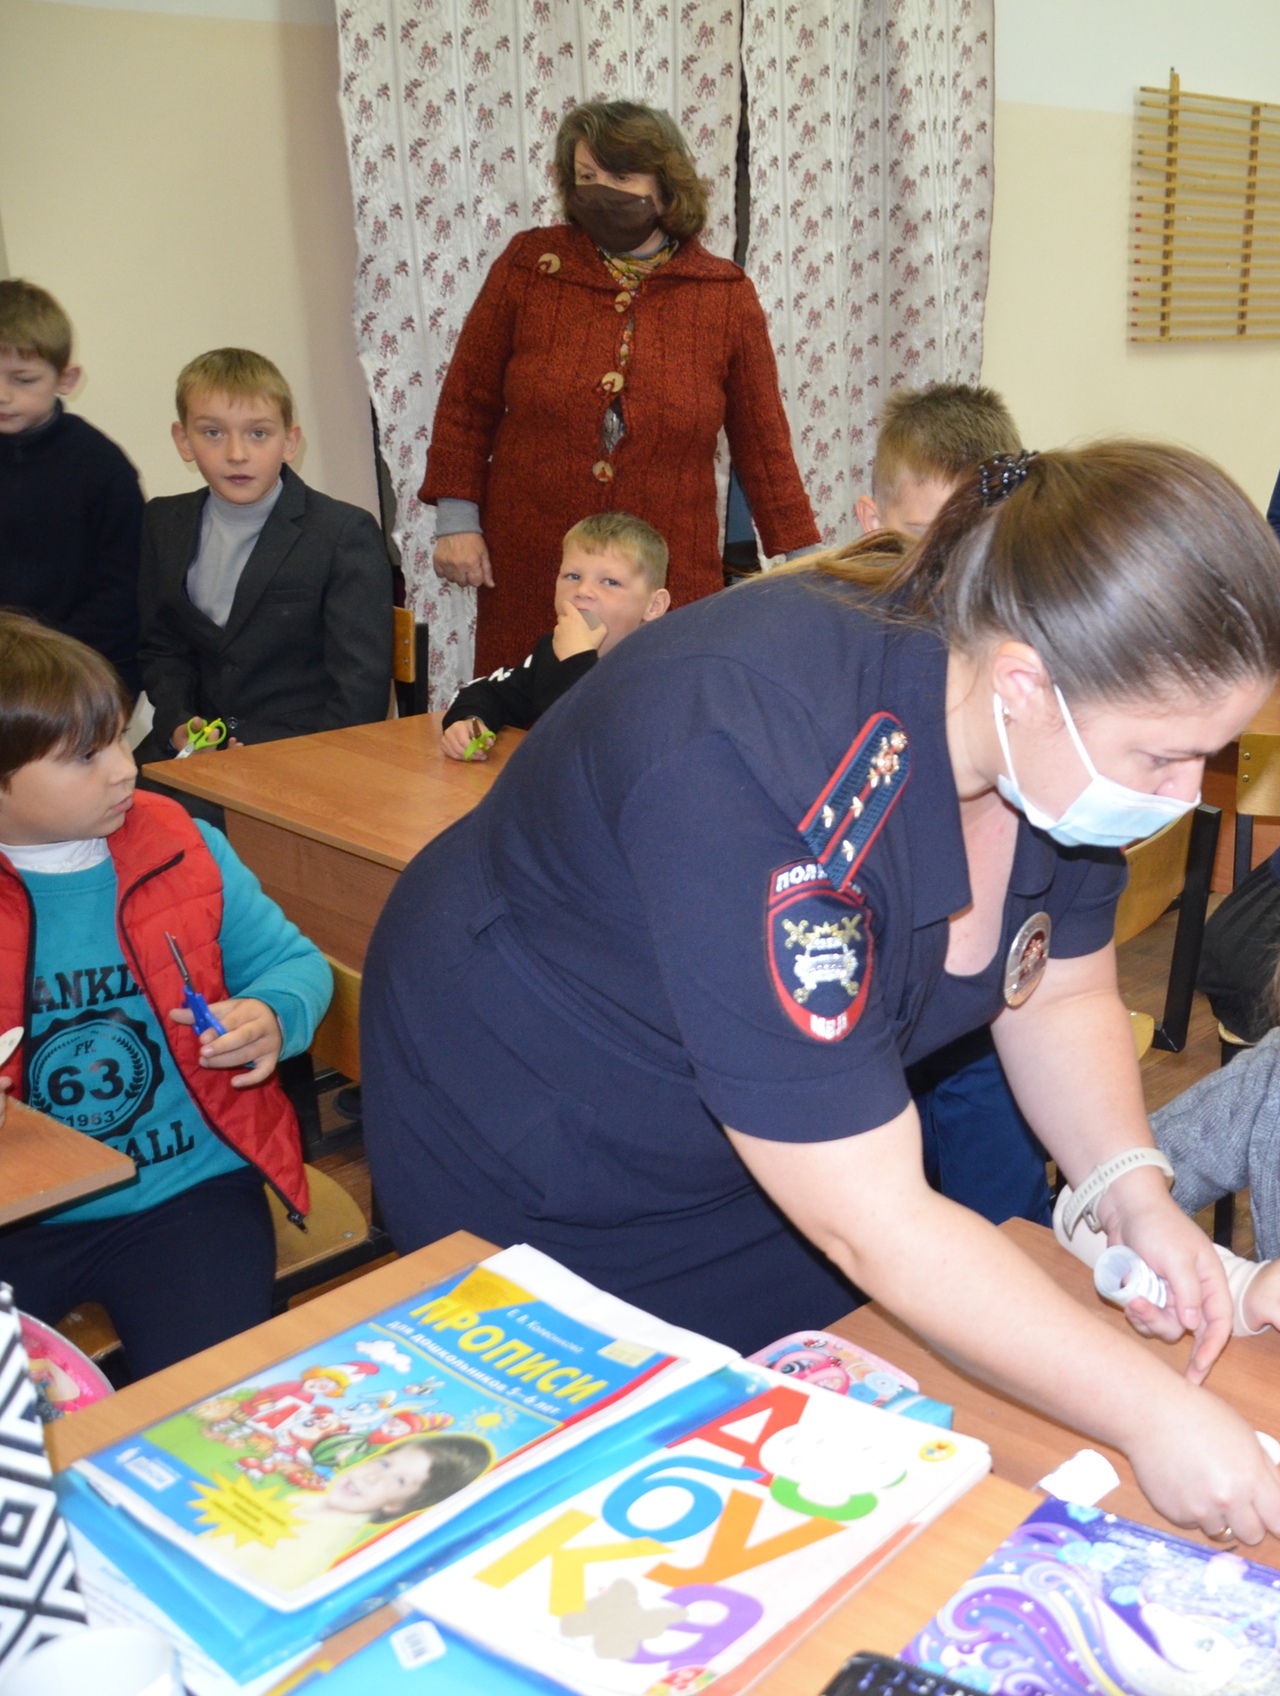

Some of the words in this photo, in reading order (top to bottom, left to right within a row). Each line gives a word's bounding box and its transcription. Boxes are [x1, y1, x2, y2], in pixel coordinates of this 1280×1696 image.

[47, 1058, 124, 1106] 63
[117, 1120, 194, 1168] ALL
[409, 1295, 608, 1404] ПРОПИСИ
[411, 1331, 508, 1395] дошкольников
